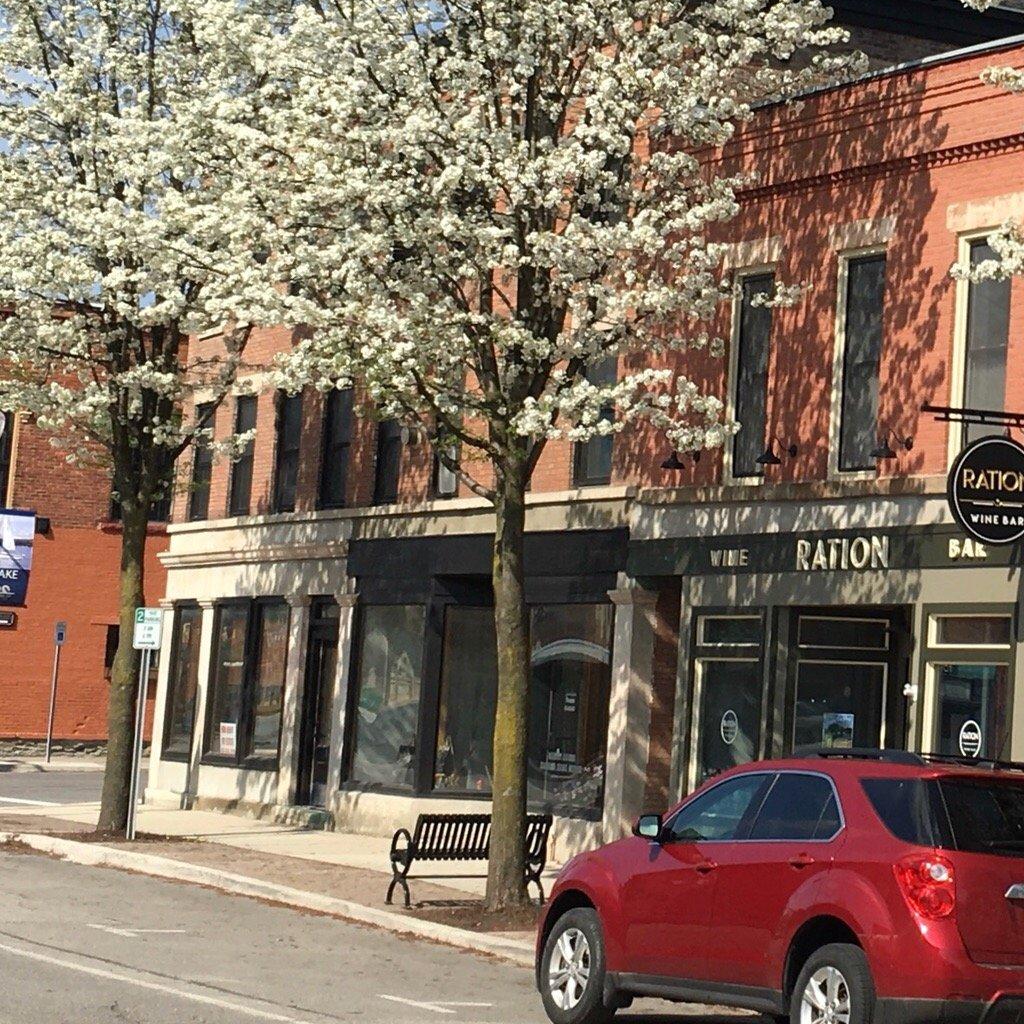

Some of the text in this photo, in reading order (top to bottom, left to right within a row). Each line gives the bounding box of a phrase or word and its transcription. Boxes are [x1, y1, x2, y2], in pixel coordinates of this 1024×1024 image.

[970, 513, 1024, 527] WINE BAR
[710, 548, 749, 567] WINE
[796, 534, 890, 571] RATION
